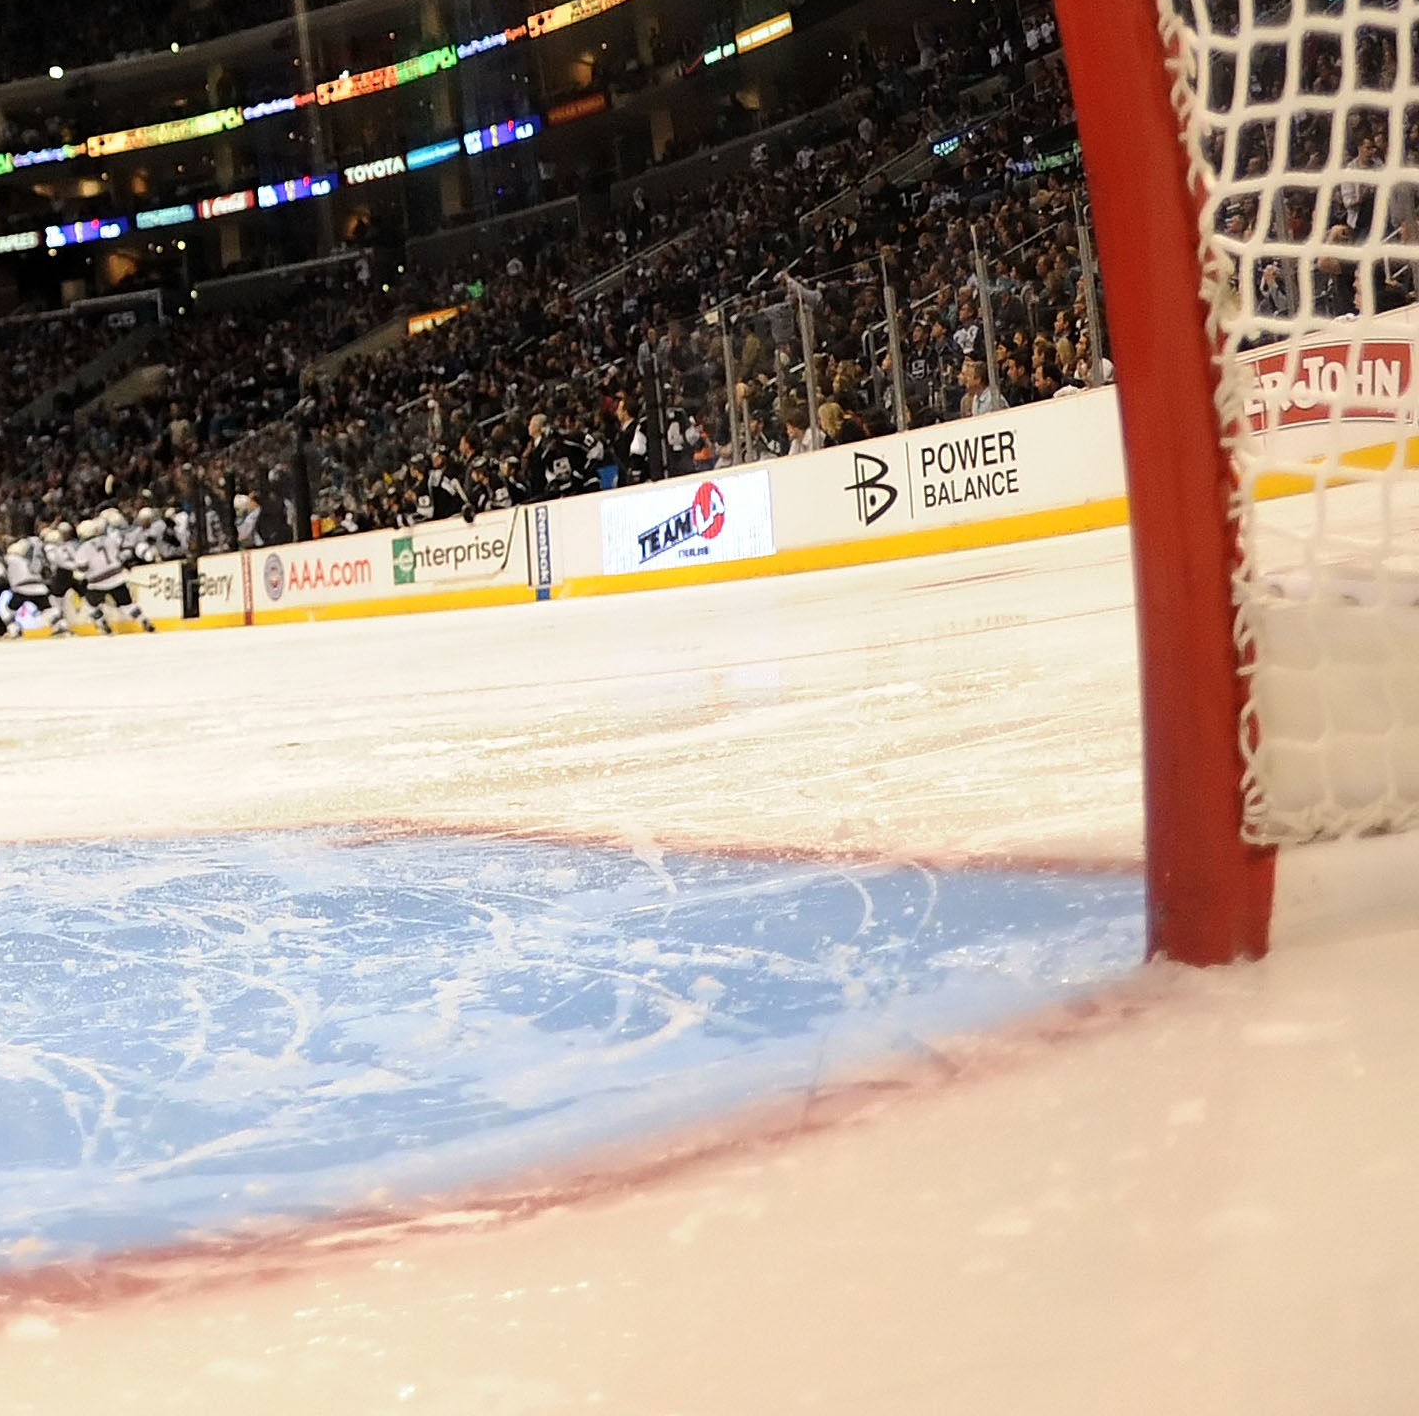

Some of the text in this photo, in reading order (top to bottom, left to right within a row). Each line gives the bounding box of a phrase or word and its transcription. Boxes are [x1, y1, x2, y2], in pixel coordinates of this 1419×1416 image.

[344, 156, 405, 184] TOYOTA
[922, 431, 1017, 478] POWER
[924, 470, 1020, 508] BALANCE
[397, 536, 506, 572] enterprise
[537, 506, 551, 584] Reebok
[639, 512, 692, 560] TEAM
[288, 556, 372, 592] AAA.com
